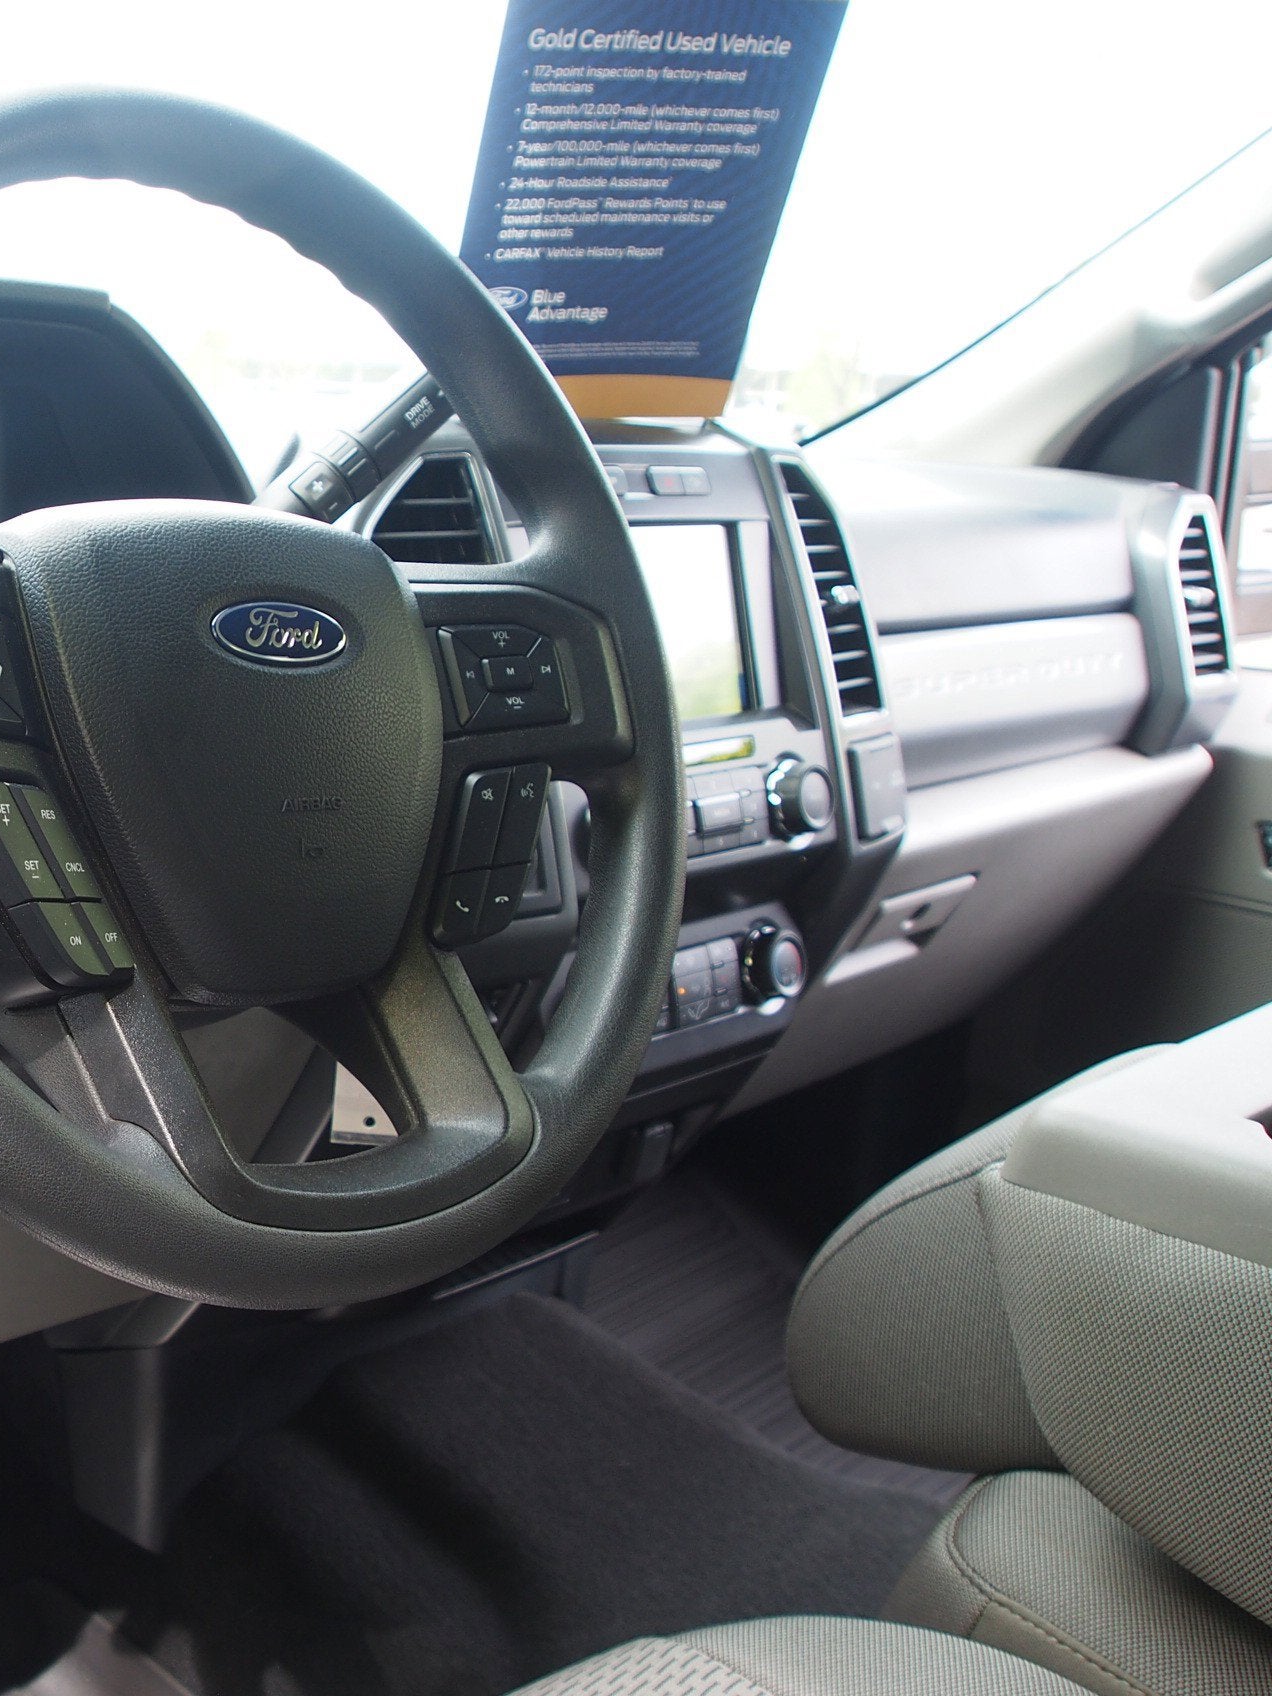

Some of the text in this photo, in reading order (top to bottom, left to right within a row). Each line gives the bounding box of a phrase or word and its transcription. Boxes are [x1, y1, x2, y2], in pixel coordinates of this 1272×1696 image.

[529, 28, 792, 55] Gold Certified Used Vehicle
[533, 65, 748, 84] 172-point inspection by factory-trained
[530, 81, 595, 94] technicians
[651, 103, 712, 118] (whichever
[713, 108, 751, 119] comes
[753, 107, 781, 121] first)
[522, 118, 608, 132] Comprehensive
[610, 119, 652, 131] Limited
[654, 120, 705, 133] Warranty
[633, 141, 694, 155] (whichever
[695, 144, 732, 154] comes
[733, 142, 761, 156] first)
[514, 155, 723, 170] Powertrain Limited Warranty coverage
[508, 177, 555, 189] 24-Hour
[557, 176, 608, 188] Roadside
[504, 197, 546, 211] 22,000
[605, 197, 652, 209] Rewards
[693, 199, 705, 209] to
[706, 200, 727, 210] use
[502, 211, 715, 224] toward scheduled maintenance visits or
[499, 226, 574, 239] other rewards
[546, 246, 585, 258] Vehicle
[586, 246, 625, 259] History
[626, 245, 665, 257] Report
[532, 289, 566, 304] Blue
[527, 306, 608, 323] Advantage
[405, 396, 431, 421] DRIVE
[410, 402, 436, 429] MODE
[244, 607, 323, 650] Ford
[492, 631, 511, 641] VOL
[505, 696, 525, 706] VOL
[41, 809, 56, 821] RES
[24, 859, 40, 872] SET
[65, 861, 86, 874] CNCL
[69, 935, 83, 947] ON
[104, 931, 119, 944] OFF
